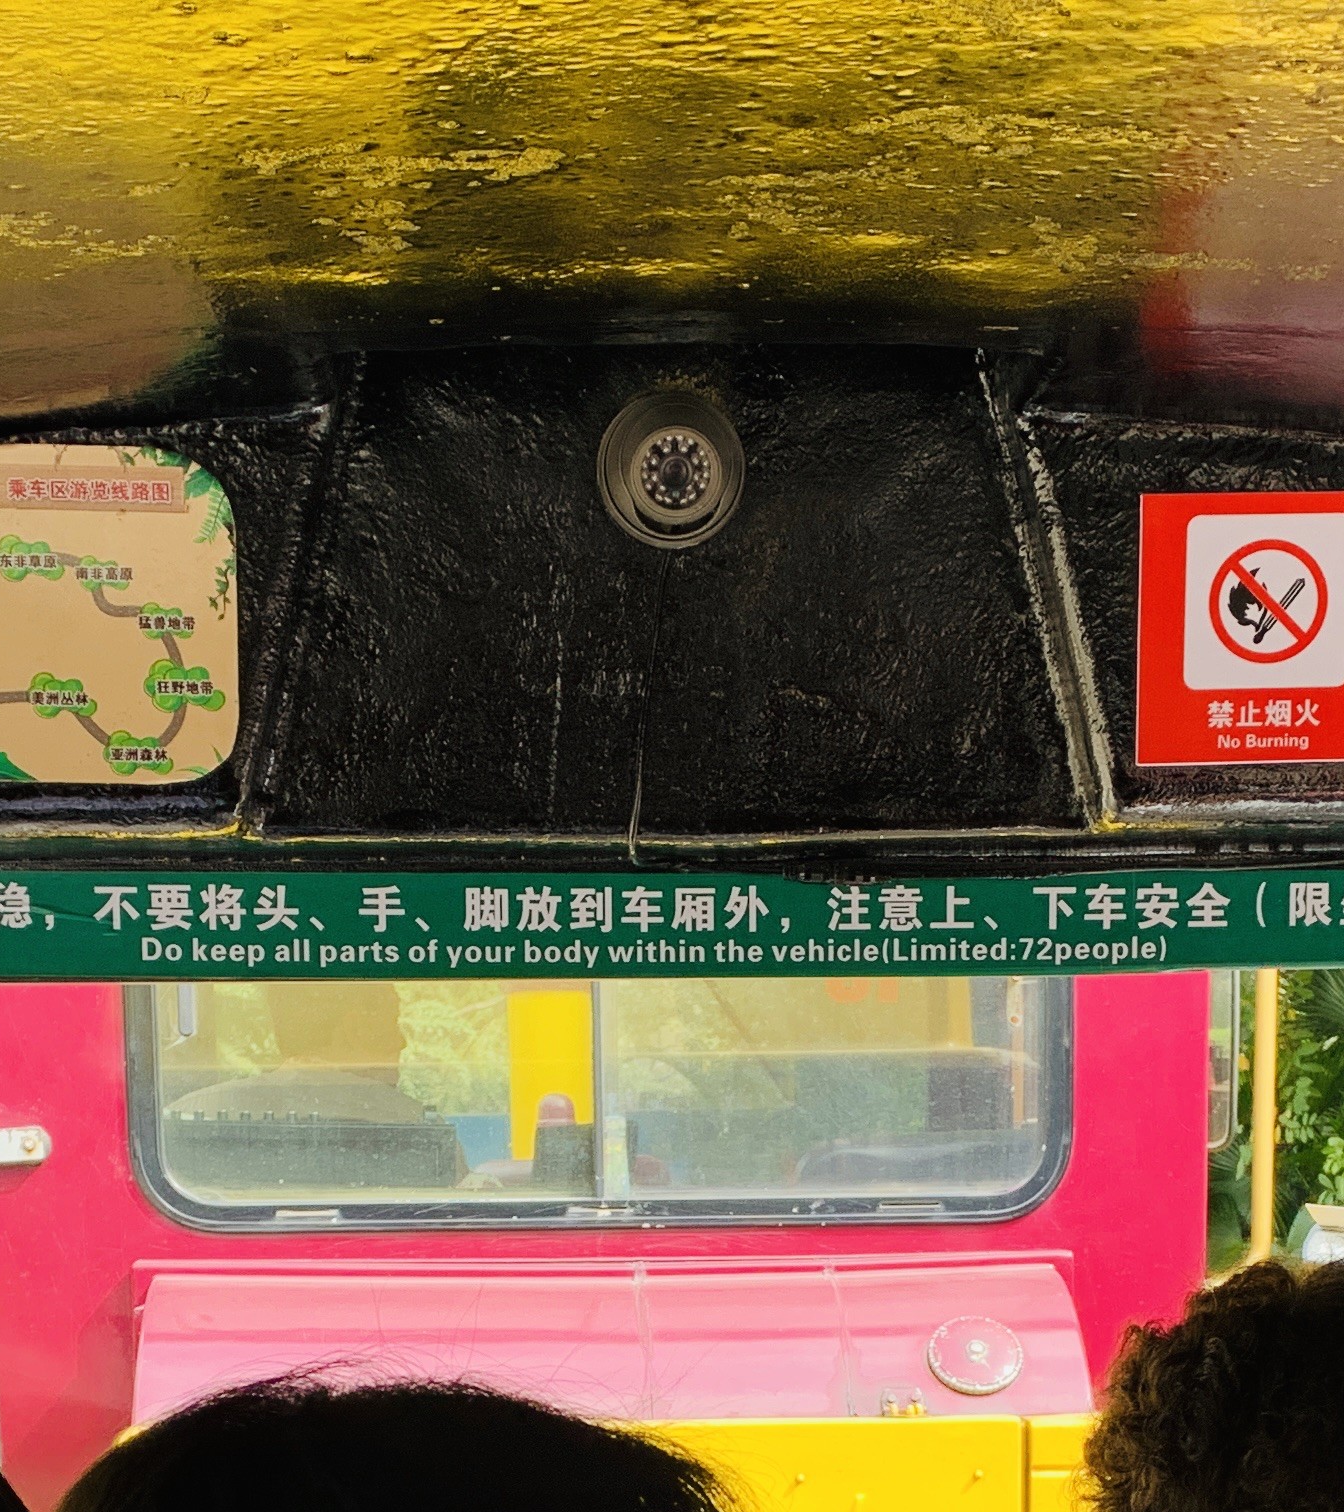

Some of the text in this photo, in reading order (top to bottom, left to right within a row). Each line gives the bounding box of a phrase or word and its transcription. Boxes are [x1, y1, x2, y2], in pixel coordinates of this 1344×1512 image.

[9, 479, 170, 502] 乘车区游览线路图
[0, 554, 57, 568] 东非草原
[76, 567, 133, 581] 南非高原
[139, 616, 196, 630] 猛兽地带
[157, 681, 214, 696] 狂野地带
[32, 692, 89, 706] 美洲丛林
[1207, 699, 1320, 729] 禁止烟火
[1217, 733, 1309, 751] No Burning
[110, 748, 168, 762] 亚洲森林
[142, 938, 182, 961] Do
[192, 938, 264, 966] keep
[274, 938, 310, 962] all
[319, 940, 399, 967] parts
[409, 939, 438, 962] of
[447, 945, 516, 968] your
[524, 939, 599, 968] body
[608, 939, 705, 963] within
[714, 940, 763, 963] the
